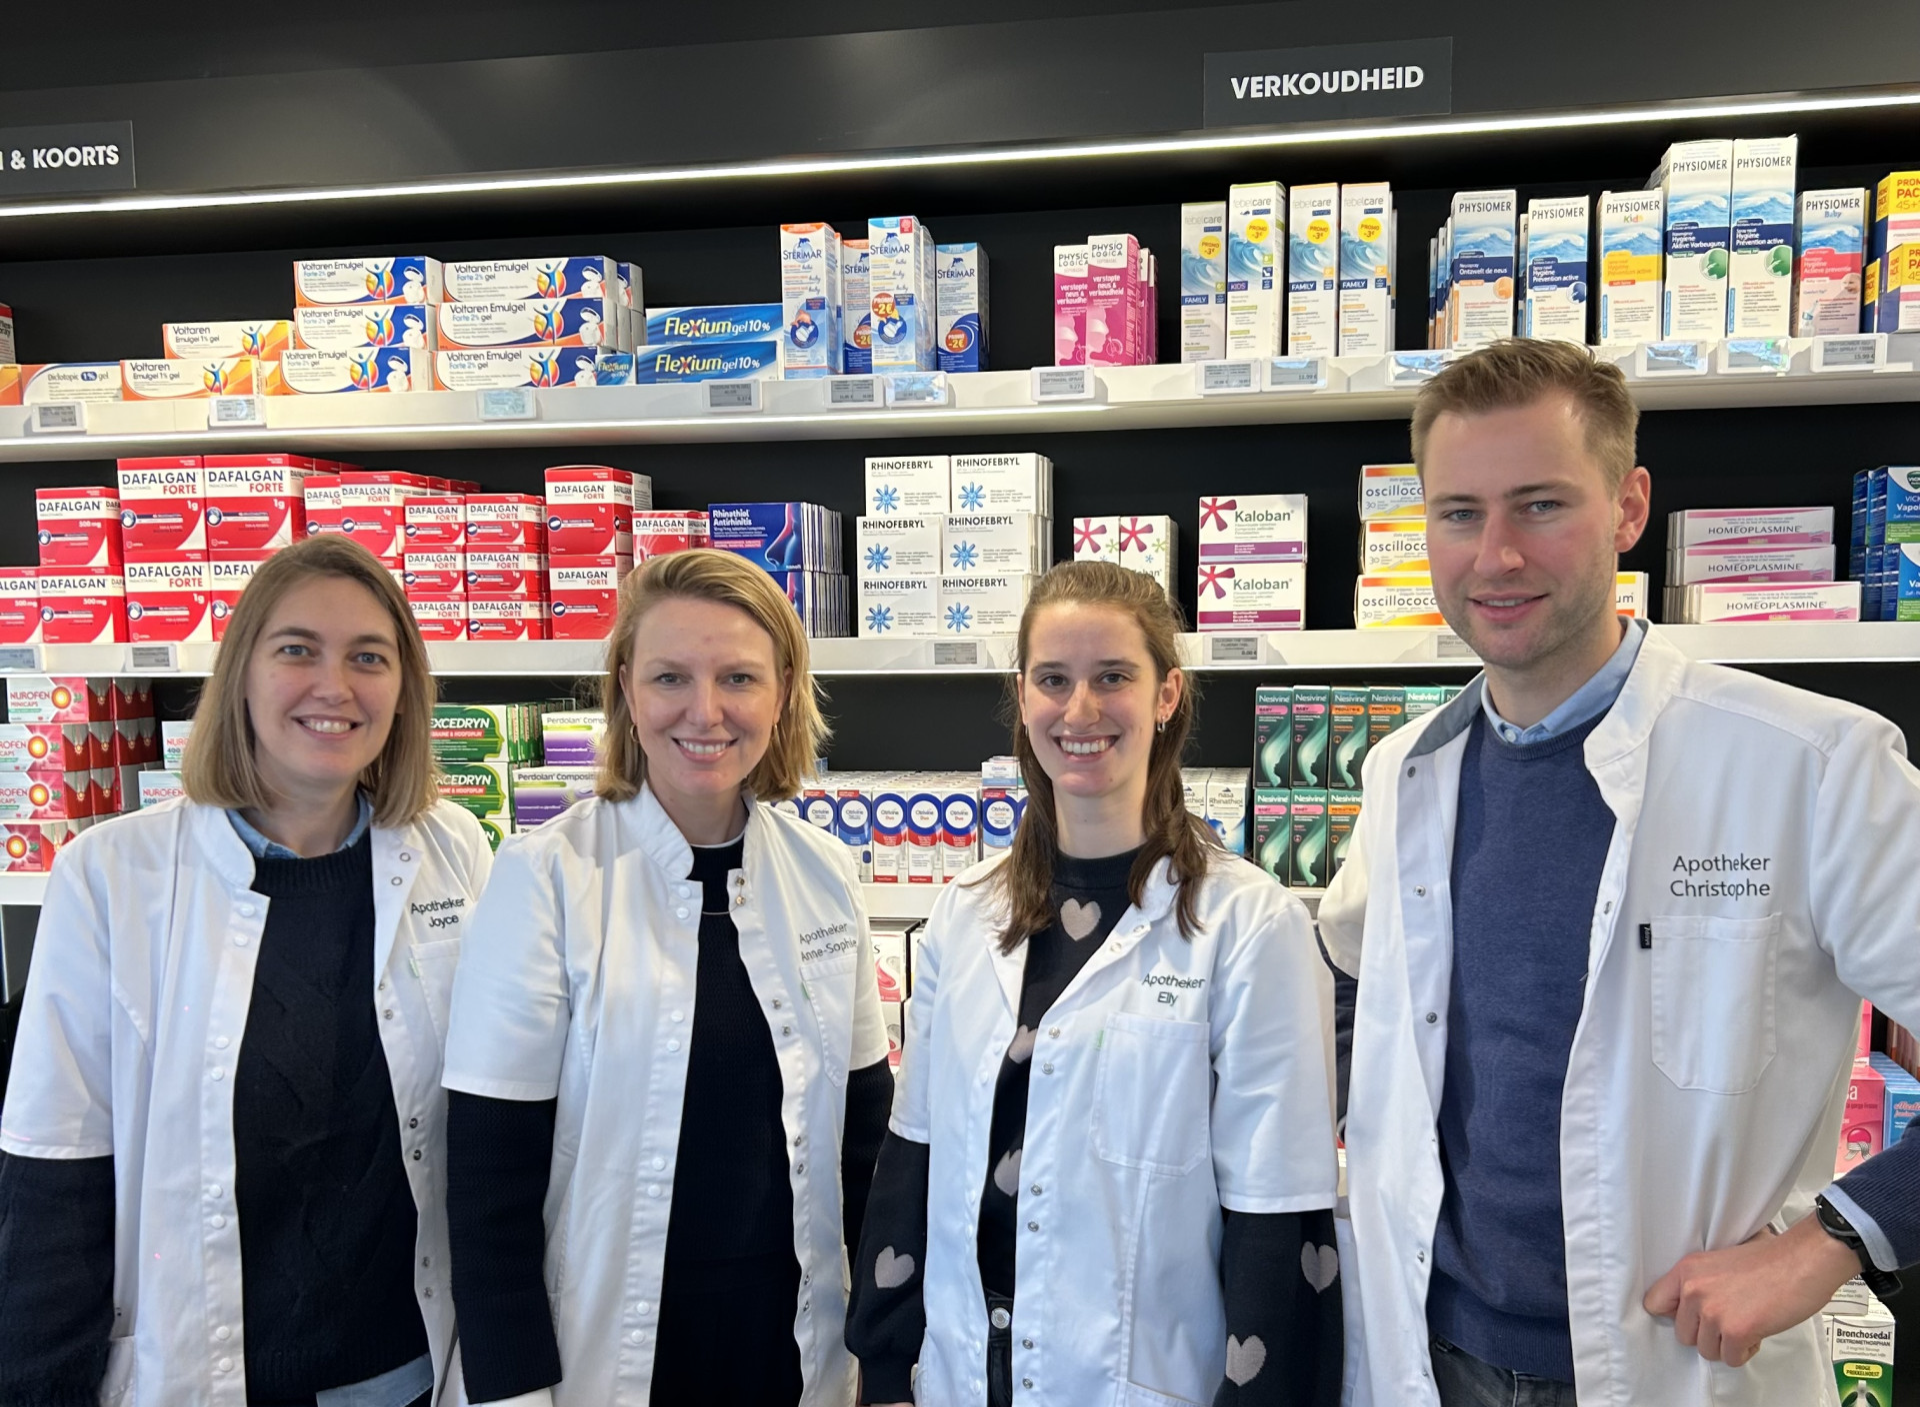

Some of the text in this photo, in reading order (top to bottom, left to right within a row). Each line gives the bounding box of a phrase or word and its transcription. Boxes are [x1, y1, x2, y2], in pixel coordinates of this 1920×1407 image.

[1231, 66, 1424, 99] VERKOUDHEID
[11, 144, 119, 170] & KOORTS
[1673, 159, 1728, 173] PHYSIOMER
[1737, 156, 1792, 170] PHYSIOMER
[1459, 201, 1512, 213] PHYSIOMER
[1606, 201, 1660, 214] PHYSIOMER
[1806, 198, 1860, 212] PHYSIOMER
[1532, 207, 1584, 220] PHYSIOMER
[301, 260, 364, 271] Voltaren Emulgel
[454, 261, 529, 273] Voltaren Emulgel
[1291, 284, 1314, 292] FAMILY
[1343, 281, 1365, 290] FAMILY
[301, 308, 364, 318] Voltaren Emulgel
[450, 302, 526, 314] Voltaren Emulgel
[173, 325, 210, 335] Voltaren
[175, 335, 199, 344] Emulgel
[285, 351, 347, 360] Voltaren Emulgel
[447, 350, 521, 361] Voltaren Emulgel
[130, 362, 170, 372] Voltaren
[133, 372, 158, 381] Emulgel
[871, 460, 934, 470] RHINOFEBRYL
[956, 457, 1021, 468] RHINOFEBRYL
[122, 472, 197, 485] DAFALGAN
[208, 470, 284, 482] DAFALGAN
[163, 484, 197, 496] FORTE
[249, 483, 284, 494] FORTE
[341, 487, 391, 497] DAFALGAN
[554, 483, 605, 494] DAFALGAN
[368, 495, 391, 504] FORTE
[583, 491, 605, 502] FORTE
[39, 501, 101, 515] DAFALGAN
[408, 506, 459, 515] DAFALGAN
[470, 505, 520, 514] DAFALGAN
[1365, 501, 1376, 510] 30
[435, 513, 459, 523] FORTE
[496, 512, 520, 521] FORTE
[713, 509, 750, 519] Rhinathiol
[1235, 511, 1291, 523] Kaloban
[635, 518, 685, 529] DAFALGAN
[713, 517, 753, 528] Antirhinitis
[862, 520, 925, 530] RHINOFEBRYL
[948, 516, 1014, 528] RHINOFEBRYL
[408, 554, 457, 564] DAFALGAN
[470, 554, 520, 563] DAFALGAN
[128, 564, 202, 578] DAFALGAN
[434, 562, 457, 571] FORTE
[496, 561, 520, 570] FORTE
[558, 571, 609, 581] DAFALGAN
[41, 578, 106, 589] DAFALGAN
[169, 577, 203, 589] FORTE
[586, 580, 609, 590] FORTE
[864, 580, 927, 591] RHINOFEBRYL
[942, 577, 1008, 589] RHINOFEBRYL
[1233, 579, 1289, 590] Kaloban
[410, 602, 461, 612] DAFALGAN
[472, 602, 522, 612] DAFALGAN
[438, 609, 461, 620] FORTE
[499, 609, 523, 619] FORTE
[10, 691, 50, 700] NUROFEN
[1259, 695, 1290, 704] Nesivine
[1295, 694, 1326, 703] Nesivine
[1335, 695, 1367, 704] Nesivine
[1371, 694, 1403, 704] Nesivine
[1407, 692, 1439, 703] Nesivine
[547, 717, 580, 725] Perdolan
[518, 773, 553, 781] Perdolan
[143, 789, 184, 797] NUROFEN
[1294, 794, 1325, 803] Nesivine
[1257, 795, 1289, 804] Nesivine
[1672, 852, 1771, 878] Apotheker
[1670, 878, 1771, 902] Christophe
[411, 897, 465, 916] Apotheker
[429, 914, 459, 929] Joyce
[799, 920, 848, 945] Apotheker
[1142, 973, 1205, 990] Apotheker
[1158, 991, 1178, 1007] Elly
[1837, 1328, 1891, 1341] Bronchosedal
